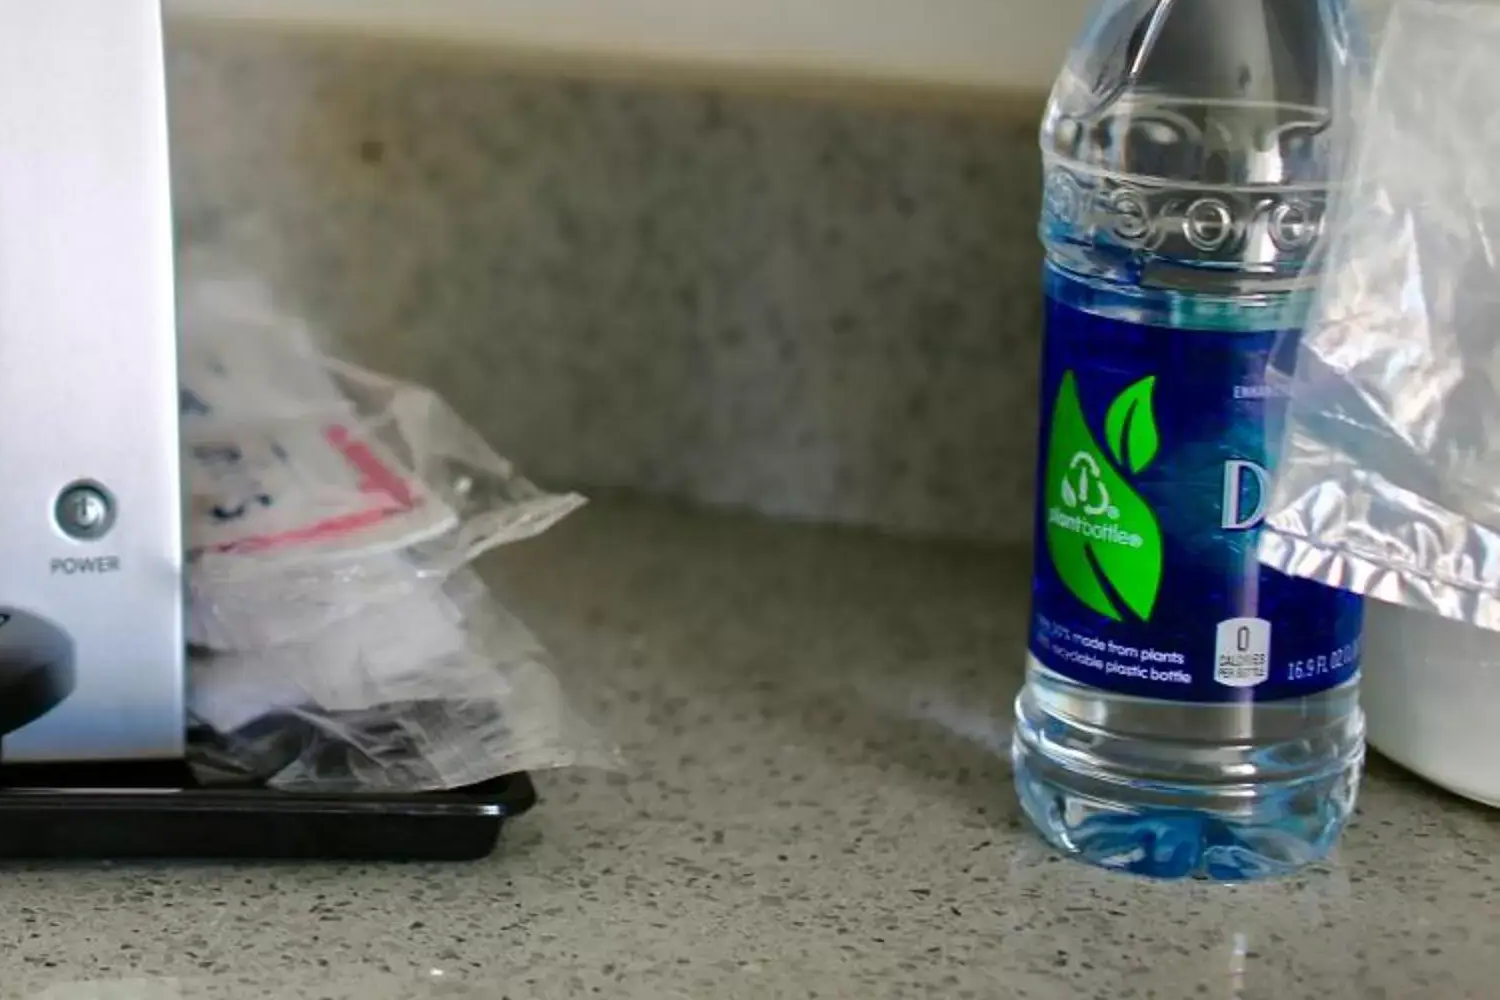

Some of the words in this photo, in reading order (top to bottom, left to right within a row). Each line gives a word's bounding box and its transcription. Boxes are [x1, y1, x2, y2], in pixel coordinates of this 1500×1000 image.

[49, 556, 121, 575] POWER
[1237, 625, 1250, 651] 0
[1108, 640, 1139, 659] from
[1140, 647, 1186, 665] plants
[1150, 666, 1192, 684] bottle
